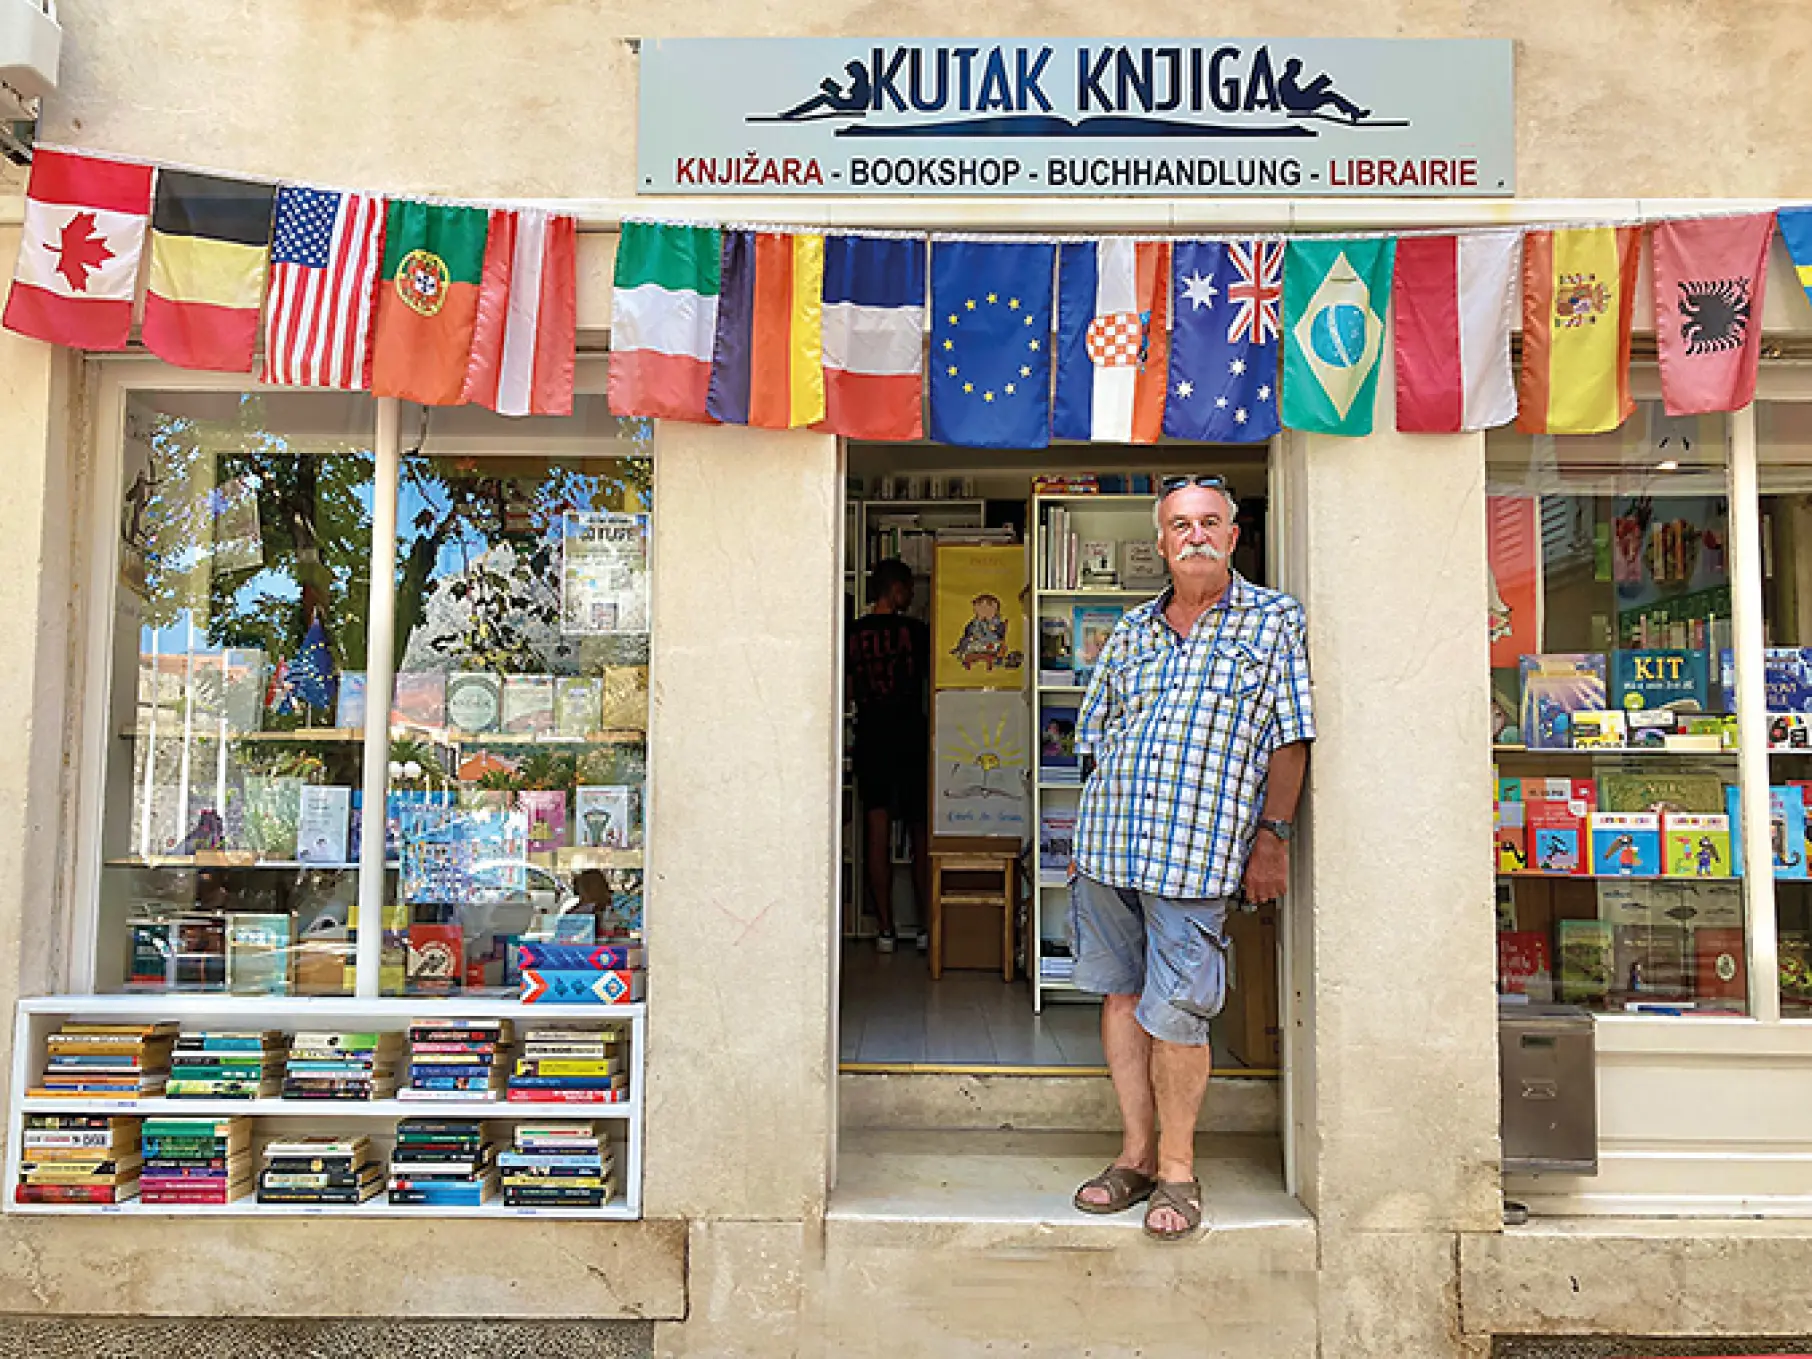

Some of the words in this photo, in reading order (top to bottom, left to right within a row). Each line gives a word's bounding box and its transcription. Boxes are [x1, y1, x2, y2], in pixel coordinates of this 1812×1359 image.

[872, 46, 1055, 112] KUTAK
[1077, 45, 1281, 113] KNJIGA
[677, 151, 824, 185] KNJIŽARA
[851, 157, 1022, 186] BOOKSHOP
[1048, 158, 1301, 186] BUCHHANDLUNG
[1330, 159, 1478, 186] LIBRAIRIE
[1634, 657, 1684, 680] KIT
